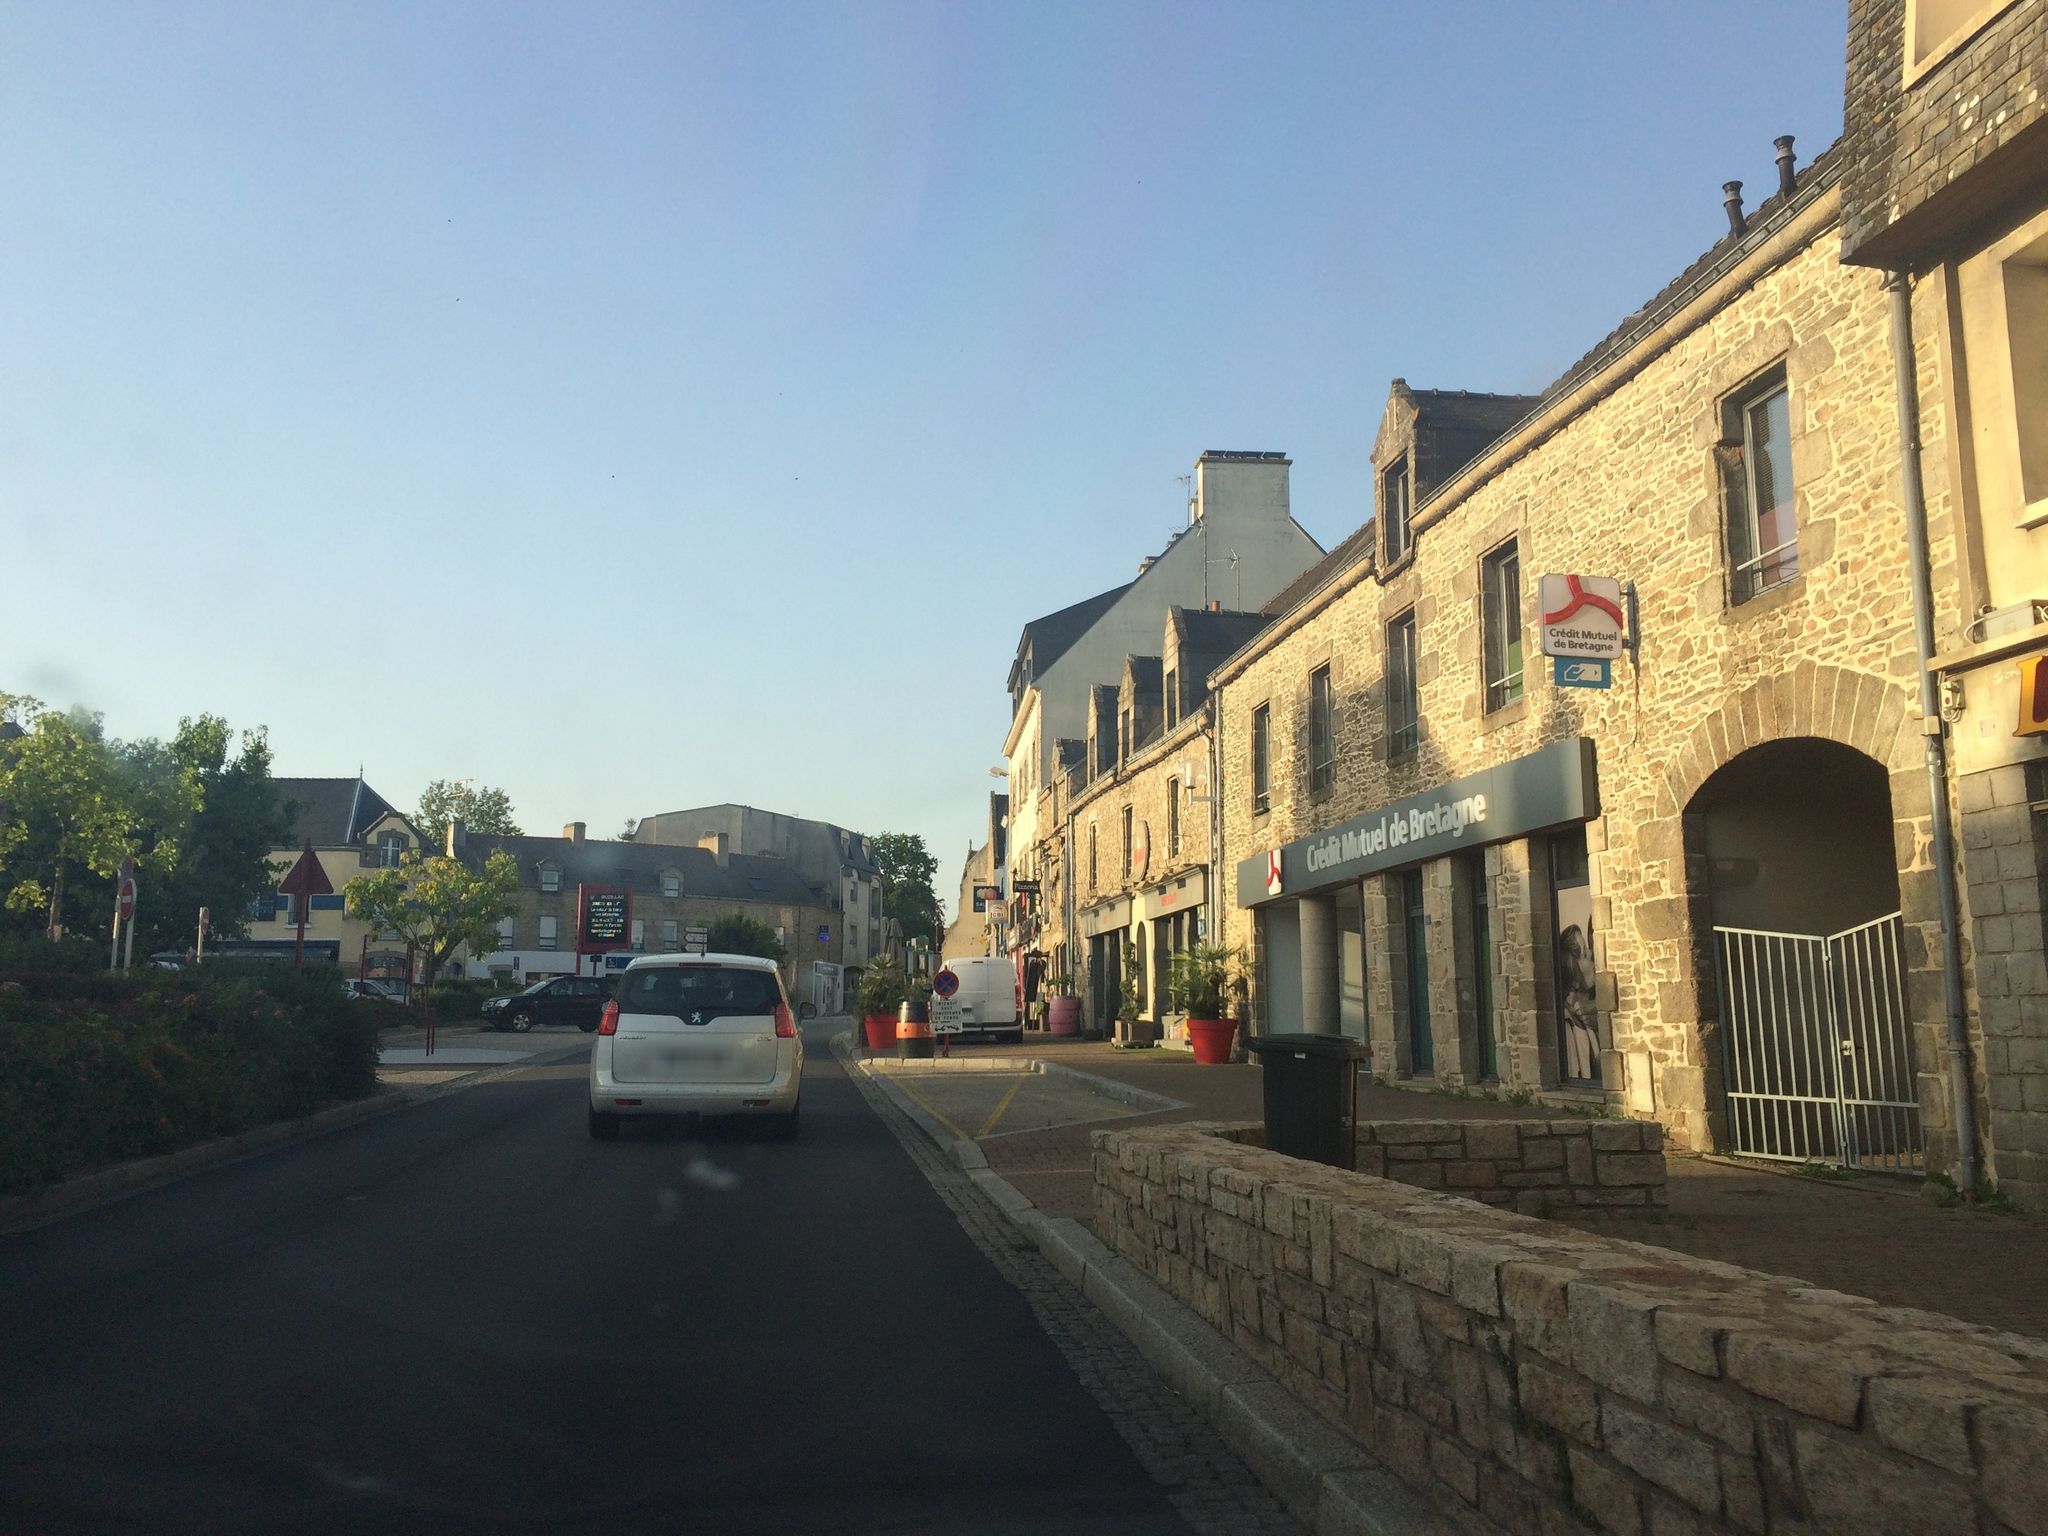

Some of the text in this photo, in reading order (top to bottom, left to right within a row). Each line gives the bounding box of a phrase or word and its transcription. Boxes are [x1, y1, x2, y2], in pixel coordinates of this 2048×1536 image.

[1549, 628, 1618, 641] Crédit Mutuel
[1553, 639, 1614, 652] de Bretagne
[1307, 793, 1487, 873] Crédit Mutuel de Bretagne
